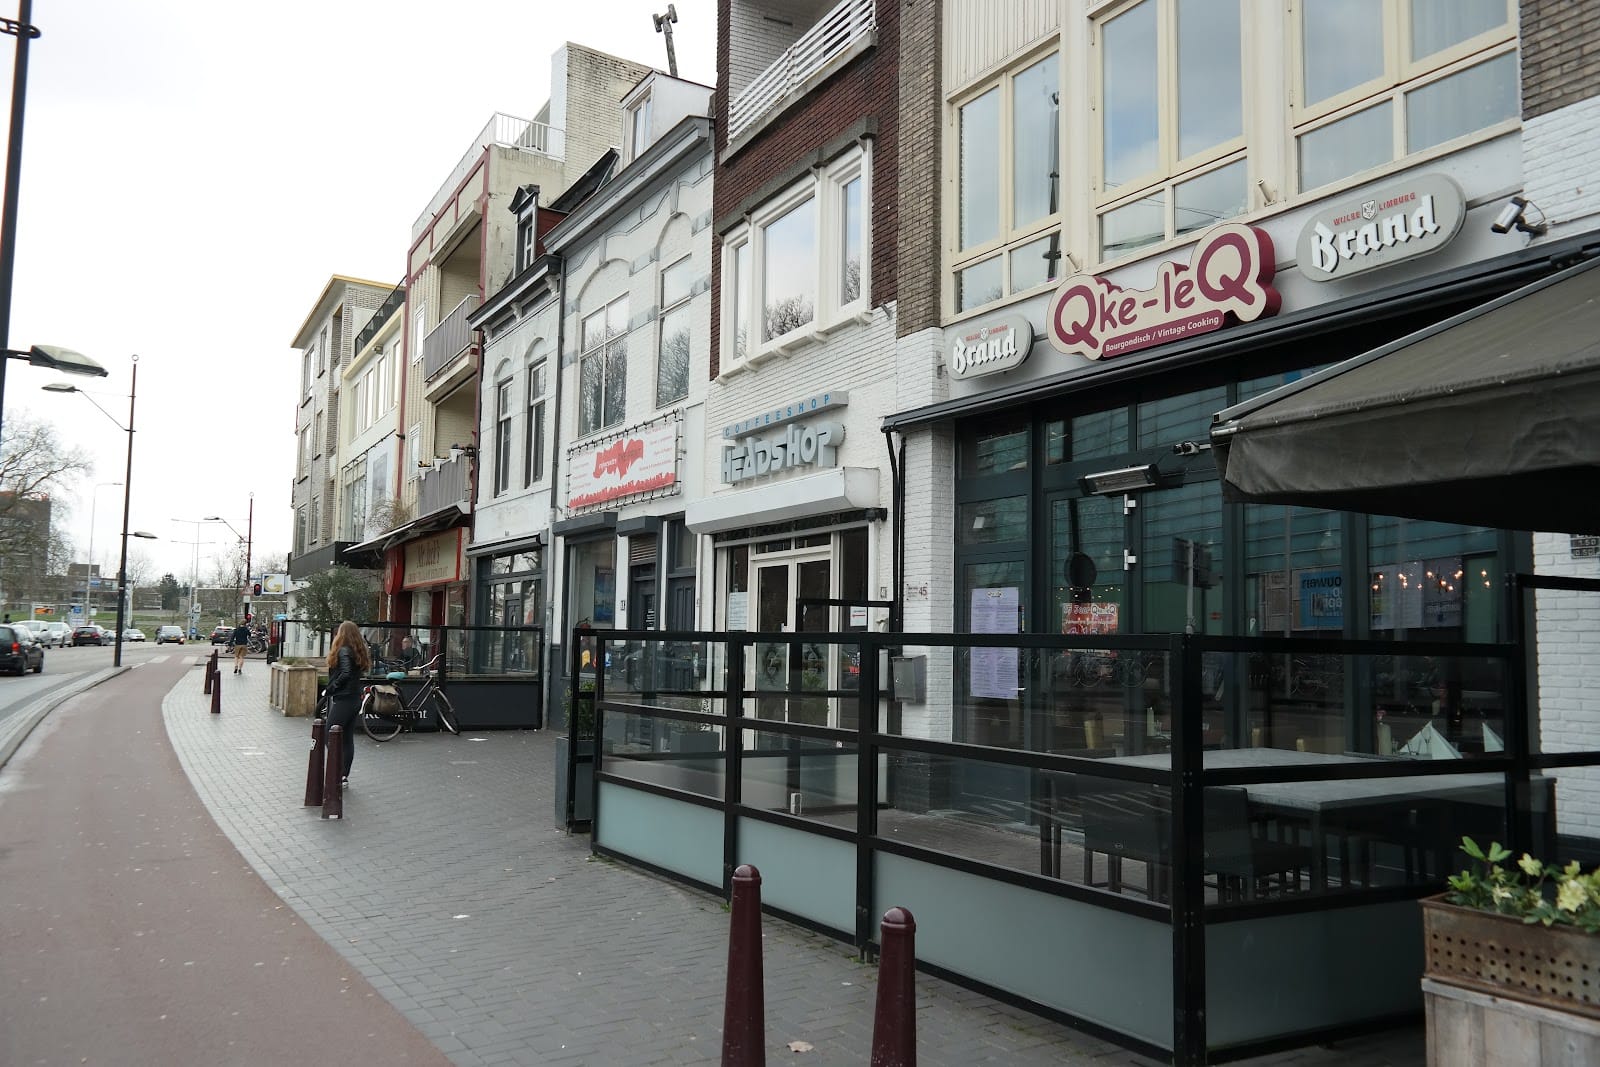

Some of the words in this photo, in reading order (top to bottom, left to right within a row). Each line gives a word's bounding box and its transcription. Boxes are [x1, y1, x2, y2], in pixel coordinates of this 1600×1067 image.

[1378, 192, 1416, 211] LIMBURG
[1311, 194, 1440, 273] Brand
[1054, 232, 1255, 350] Qke-leQ
[953, 328, 1017, 375] Brand
[1105, 333, 1151, 353] Bourgondisch
[1157, 324, 1186, 339] Vintage
[1187, 315, 1219, 332] Cooking
[725, 394, 830, 437] COFFEESHOP
[721, 421, 840, 484] HEADSHOP
